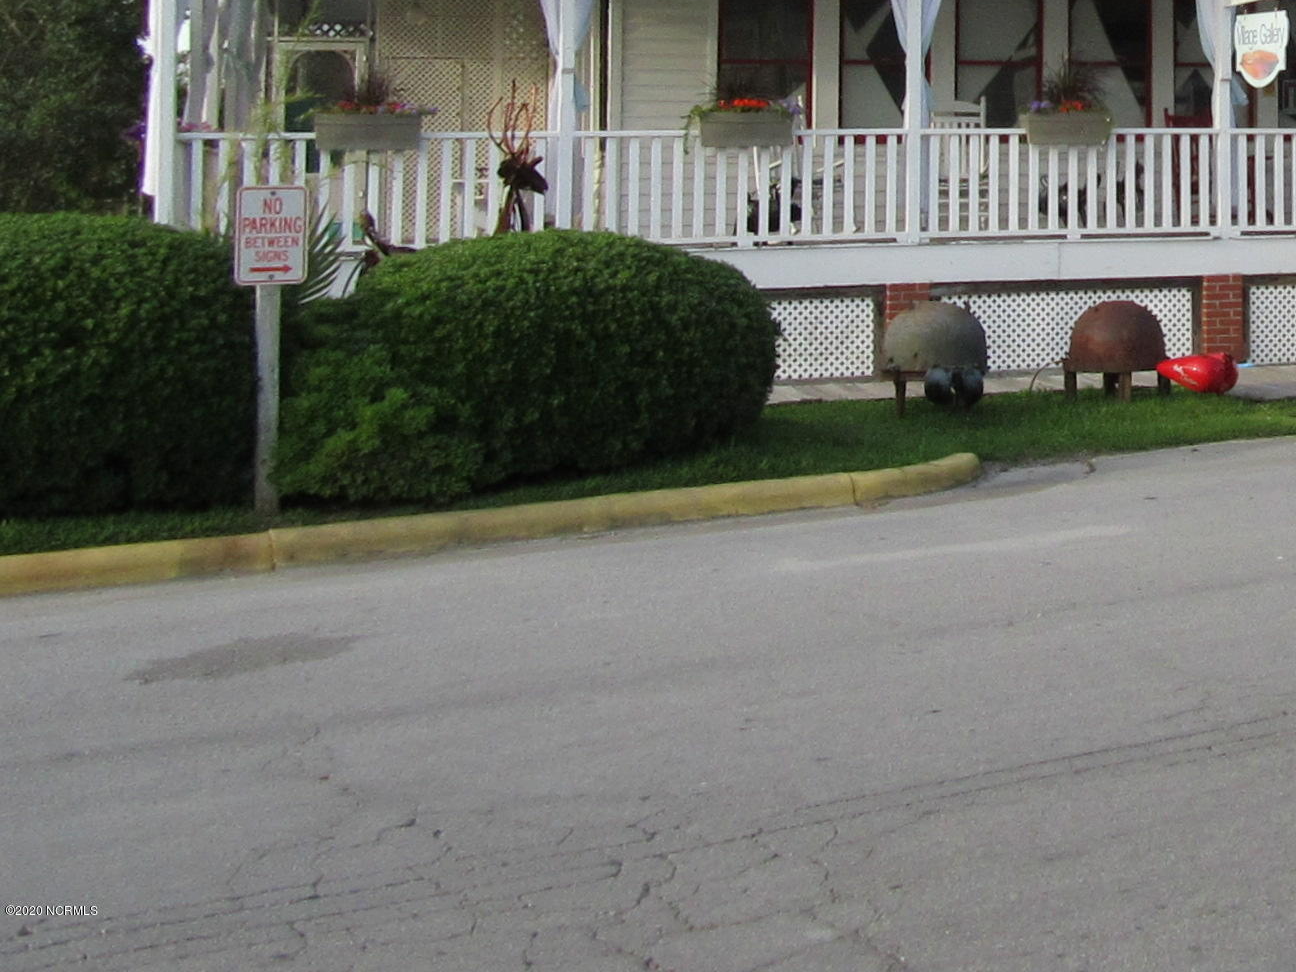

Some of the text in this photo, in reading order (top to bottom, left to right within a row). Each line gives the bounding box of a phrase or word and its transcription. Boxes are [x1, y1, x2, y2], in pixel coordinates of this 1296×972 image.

[263, 197, 283, 215] NO
[242, 217, 304, 234] PARKING
[245, 236, 300, 248] BETWEEN
[255, 250, 289, 262] SIGNS
